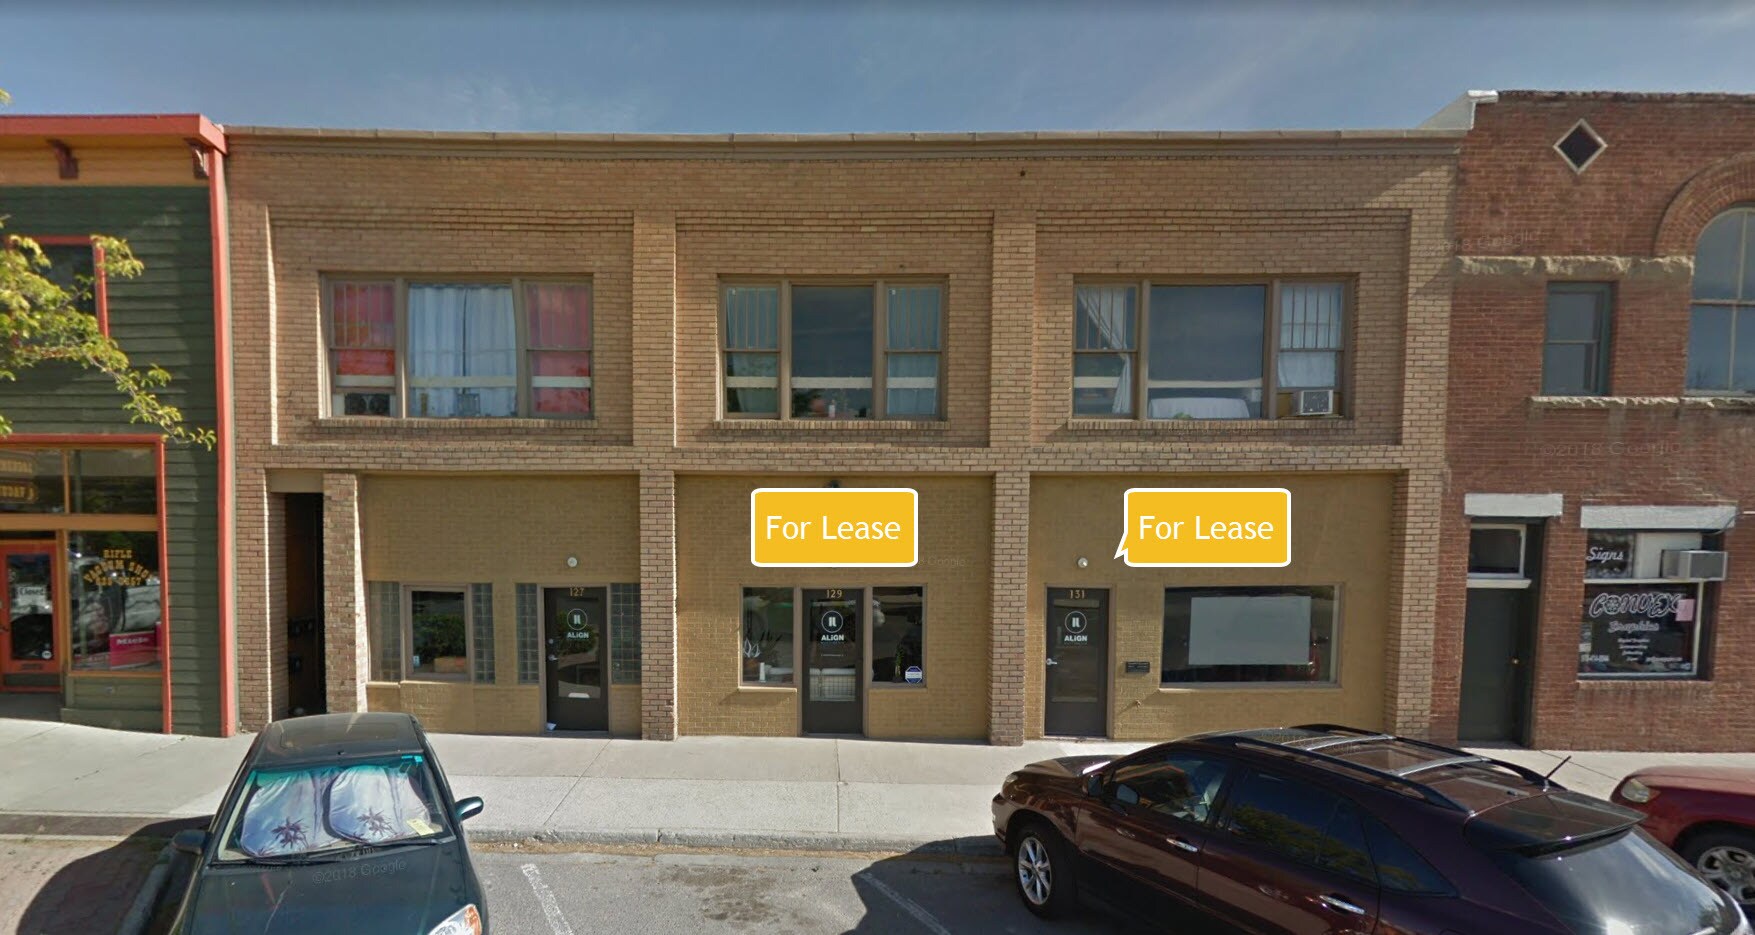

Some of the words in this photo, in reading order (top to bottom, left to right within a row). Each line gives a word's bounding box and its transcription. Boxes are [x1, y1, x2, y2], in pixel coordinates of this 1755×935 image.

[103, 549, 133, 559] RIFLE
[1586, 546, 1624, 564] Signs
[570, 585, 585, 597] 127
[826, 589, 843, 599] 129
[1070, 589, 1085, 599] 131
